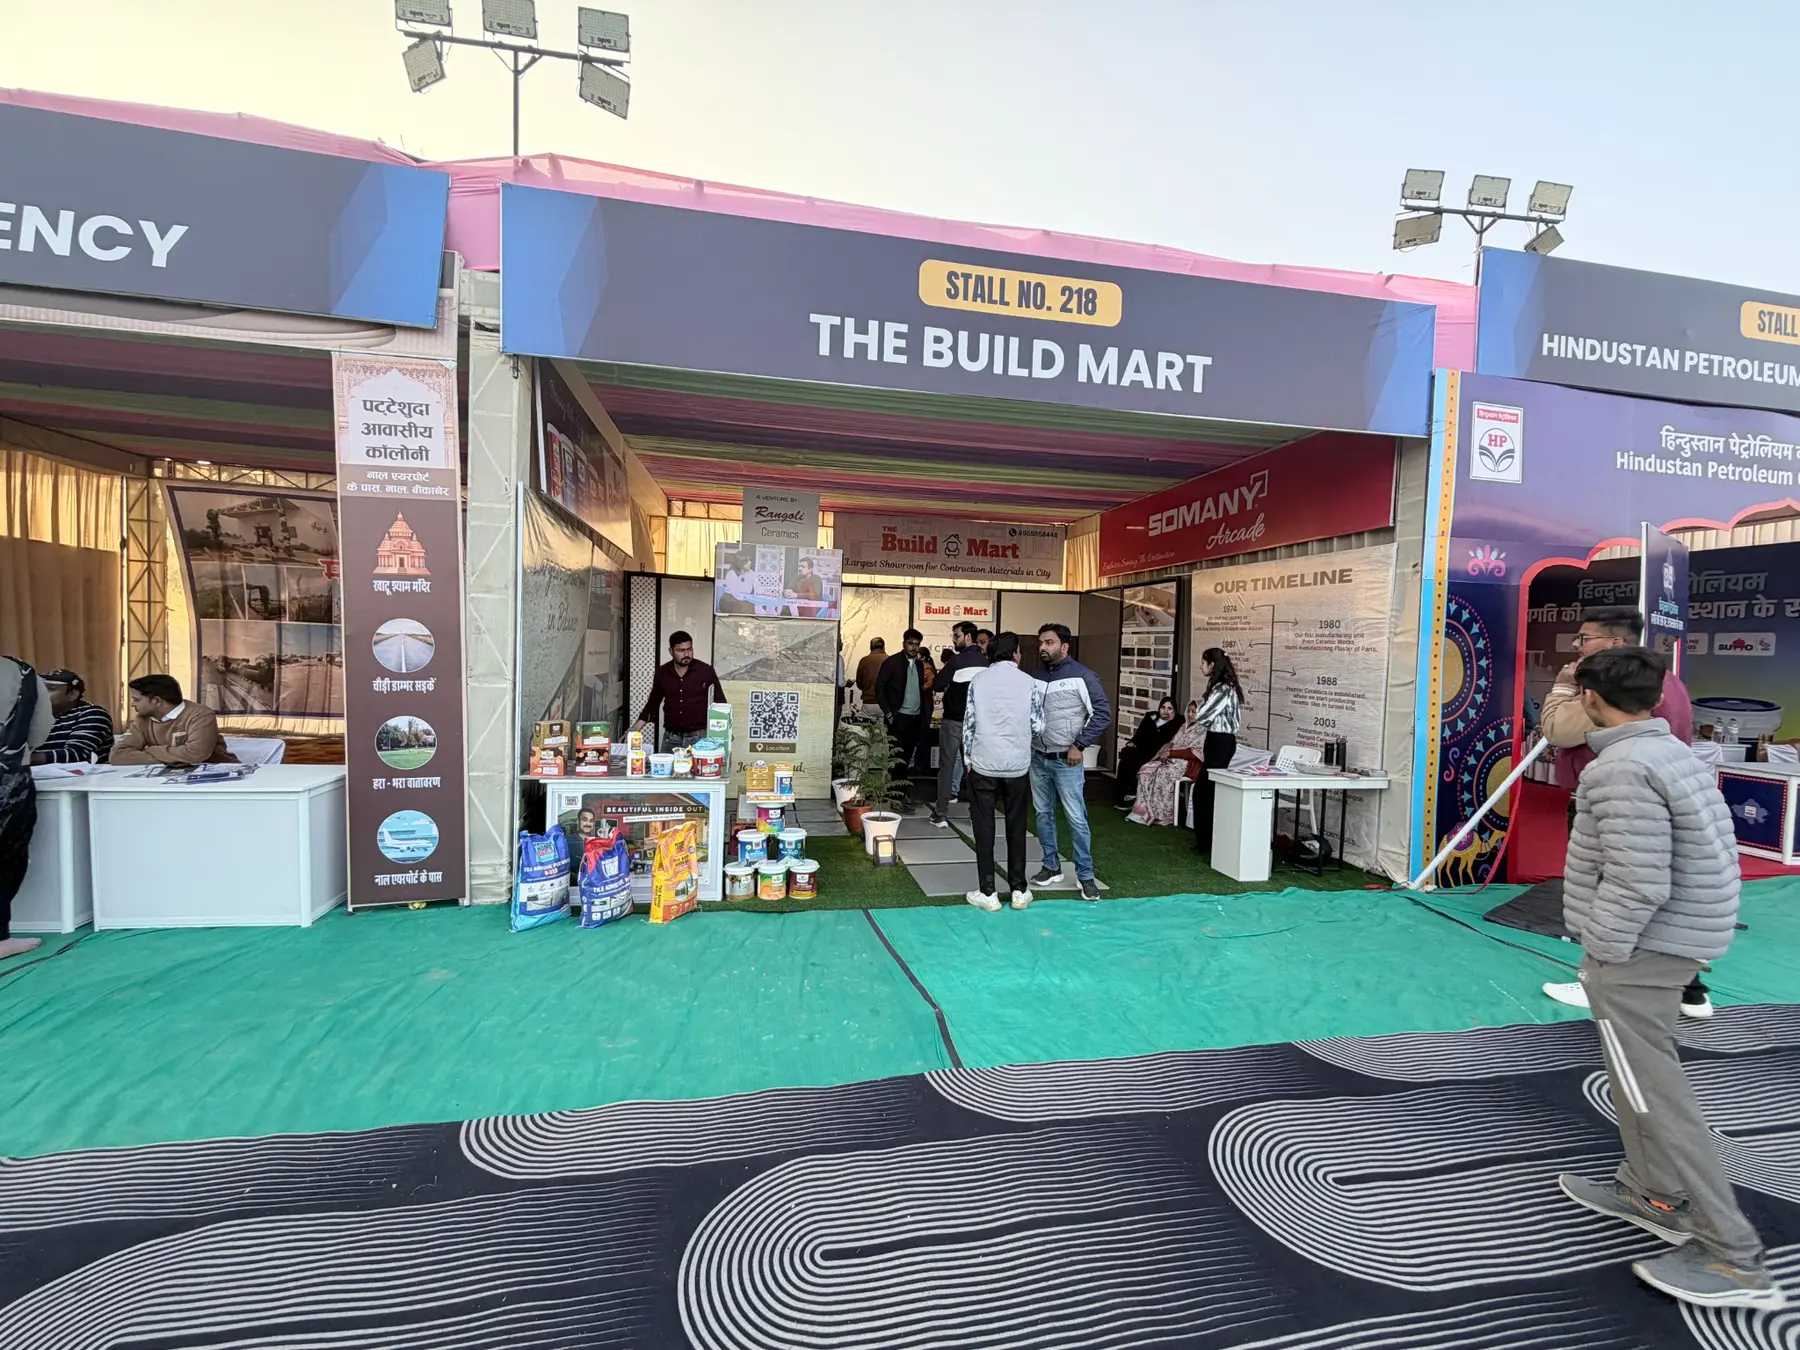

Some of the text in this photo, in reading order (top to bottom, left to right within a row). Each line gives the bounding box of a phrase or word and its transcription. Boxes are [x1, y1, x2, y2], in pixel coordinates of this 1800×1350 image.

[0, 202, 189, 268] ENCY
[946, 270, 1098, 316] STALL NO. 218
[1757, 309, 1798, 338] STALL
[809, 313, 1212, 393] THE BUILD MART
[1542, 333, 1679, 372] HINDUSTAN
[361, 421, 433, 439] आवासीय
[1487, 433, 1508, 448] HP
[1660, 425, 1726, 457] हिन्दुस्तान
[1728, 432, 1794, 460] पेट्रोलियम
[365, 444, 431, 461] कॉलोनी
[366, 470, 430, 482] नाल एयरपोर्ट
[1616, 451, 1702, 477] Hindustan
[1707, 460, 1793, 485] Petroleum
[347, 481, 358, 491] के
[754, 506, 805, 523] Rangoli
[1149, 479, 1264, 537] SOMANY
[761, 526, 799, 539] Ceramics
[883, 525, 898, 533] THE
[1206, 513, 1266, 550] Arcade
[881, 533, 1020, 560] Build Mart
[844, 557, 1051, 580] Largest Showroom for Contruction Materials in City
[1213, 568, 1353, 594] OUR TIMELINE
[1577, 579, 1640, 603] हिन्दुस्त
[925, 605, 988, 616] Build Mart
[1223, 605, 1237, 613] 1974
[1560, 602, 1581, 622] की
[1688, 600, 1748, 619] स्थान
[1752, 594, 1778, 618] के
[1319, 619, 1341, 629] 1980
[1222, 640, 1236, 648] 1987
[1316, 676, 1338, 686] 1988
[1334, 690, 1366, 699] established
[1313, 717, 1336, 728] 2003
[373, 778, 386, 789] हरा
[392, 777, 406, 789] भरा
[407, 776, 441, 788] वातावरण
[374, 869, 443, 886] नाल एयरपोर्ट के पास
